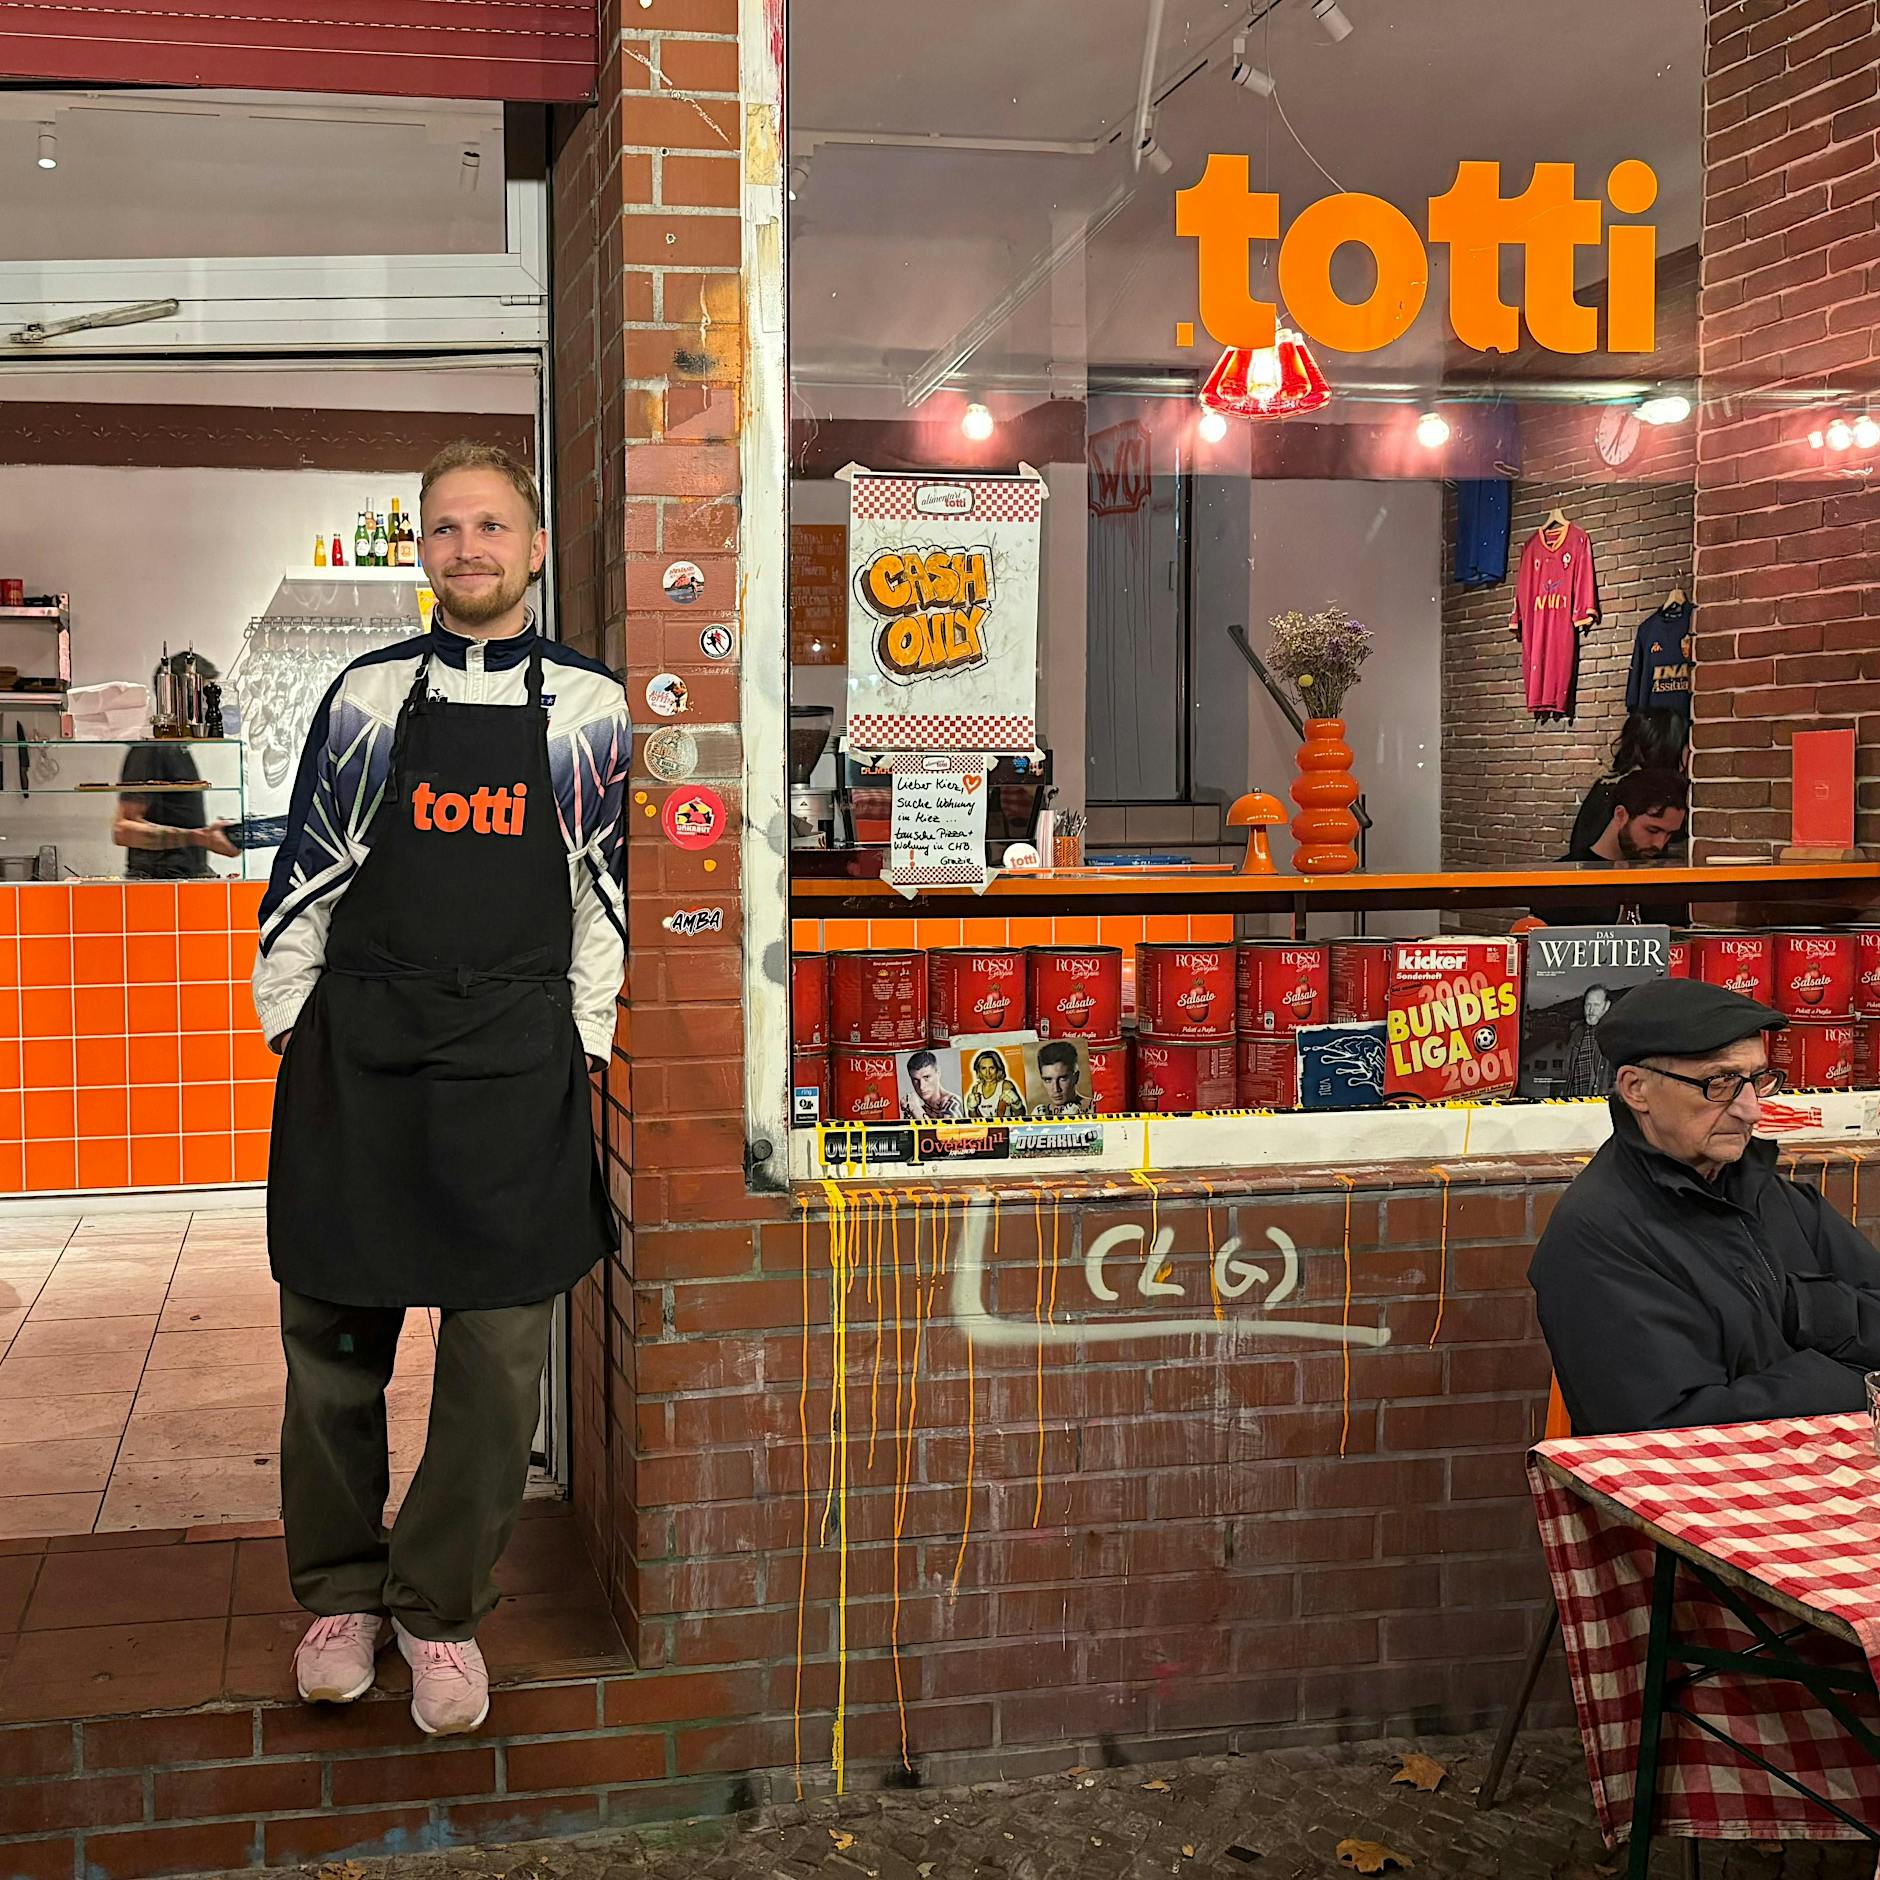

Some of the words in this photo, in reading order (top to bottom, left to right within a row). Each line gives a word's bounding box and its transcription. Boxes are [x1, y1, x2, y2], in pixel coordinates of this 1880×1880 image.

[1176, 154, 1658, 355] totti
[921, 490, 963, 506] alimentari
[944, 497, 966, 508] totti
[865, 551, 989, 614] CASH
[881, 605, 986, 672] ONLY
[1652, 664, 1689, 680] INA
[897, 776, 932, 791] Lieber
[411, 782, 528, 836] totti
[897, 797, 933, 810] Suche
[936, 797, 976, 816] Wohnung
[915, 811, 941, 823] Kiez
[1009, 852, 1038, 867] totti
[671, 909, 721, 932] AMBA
[1596, 931, 1615, 939] DAS
[1538, 938, 1666, 968] WETTER
[1721, 940, 1763, 954] ROSSO
[1790, 938, 1837, 952] ROSSO
[972, 958, 1014, 972] ROSSO
[1056, 958, 1100, 972] ROSSO
[1175, 953, 1219, 968] ROSSO
[1281, 951, 1321, 965] ROSSO
[1398, 949, 1467, 970] kicker
[1396, 971, 1442, 980] Sonderheft
[1722, 976, 1760, 991] Salsato
[1791, 973, 1833, 989] Salsato
[974, 995, 1011, 1013] Salsato
[1056, 995, 1097, 1012] Salsato
[1177, 991, 1217, 1007] Salsato
[1282, 988, 1318, 1005] Salsato
[1387, 982, 1517, 1044] BUNDES
[1391, 1030, 1473, 1077] LIGA
[850, 1058, 894, 1072] ROSSO
[1441, 1047, 1514, 1092] 2001
[800, 1088, 813, 1097] ring
[851, 1098, 892, 1113] Salsato
